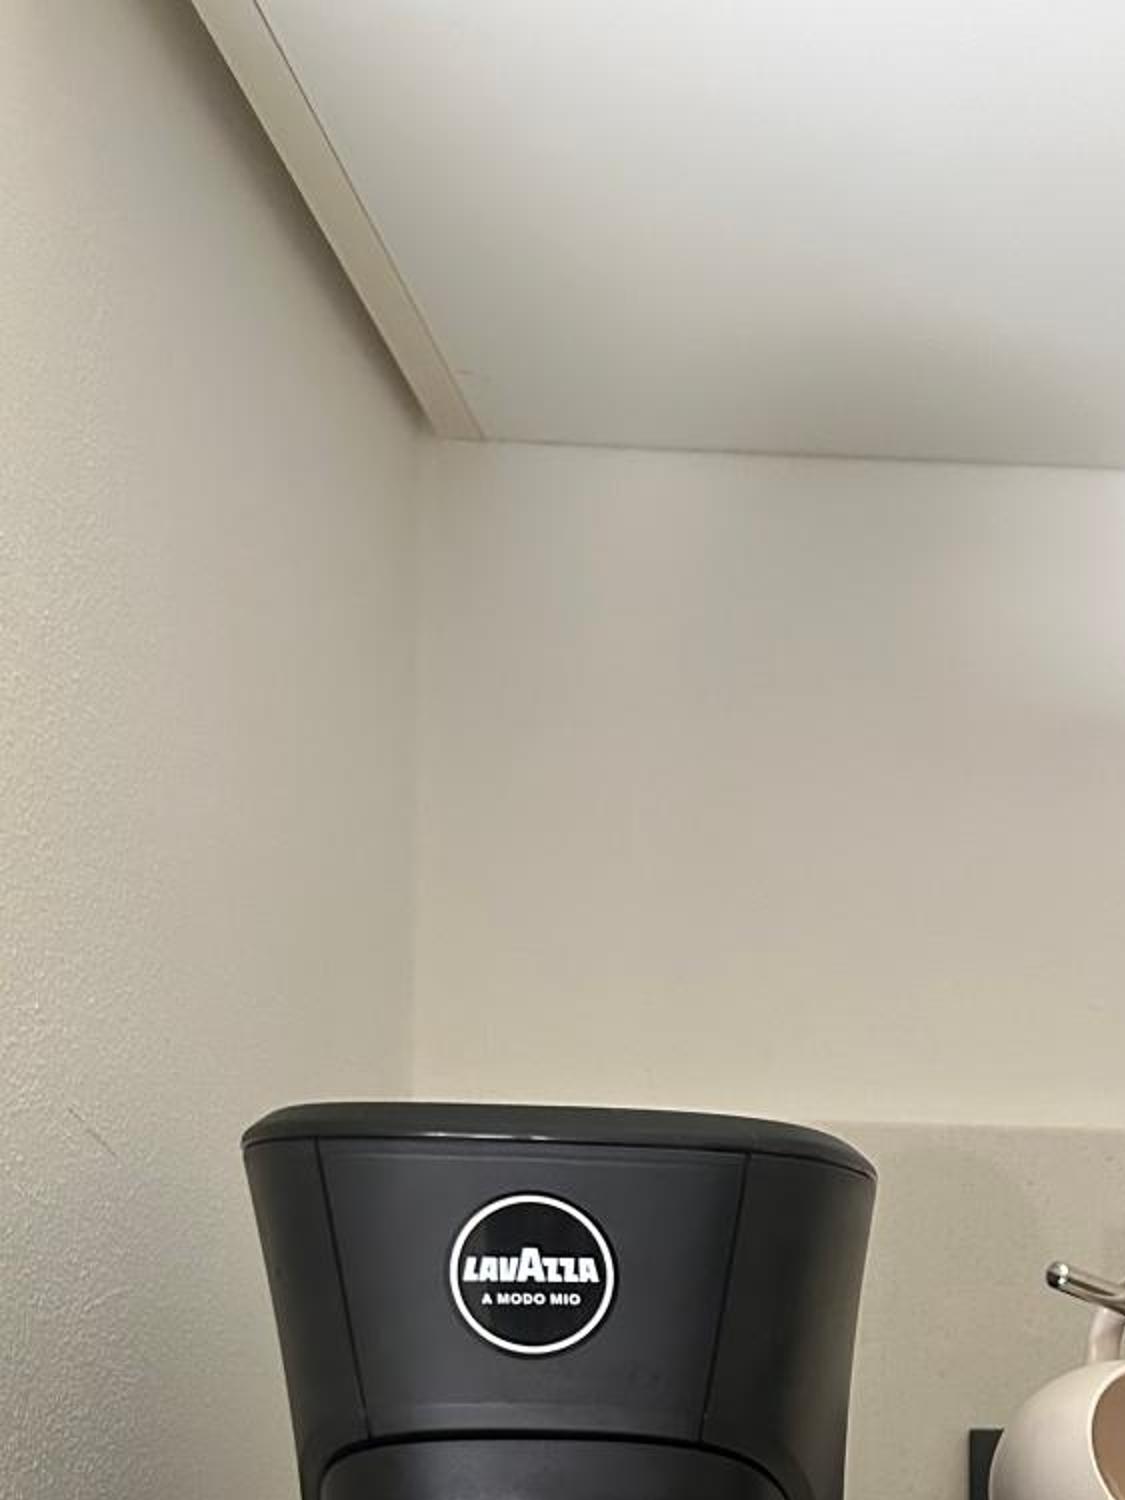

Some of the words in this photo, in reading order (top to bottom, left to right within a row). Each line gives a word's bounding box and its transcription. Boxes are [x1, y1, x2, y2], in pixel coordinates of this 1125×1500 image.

[463, 1247, 600, 1283] LAVAZZA
[481, 1293, 493, 1305] A
[497, 1293, 546, 1305] MODO
[549, 1293, 581, 1305] MIO
